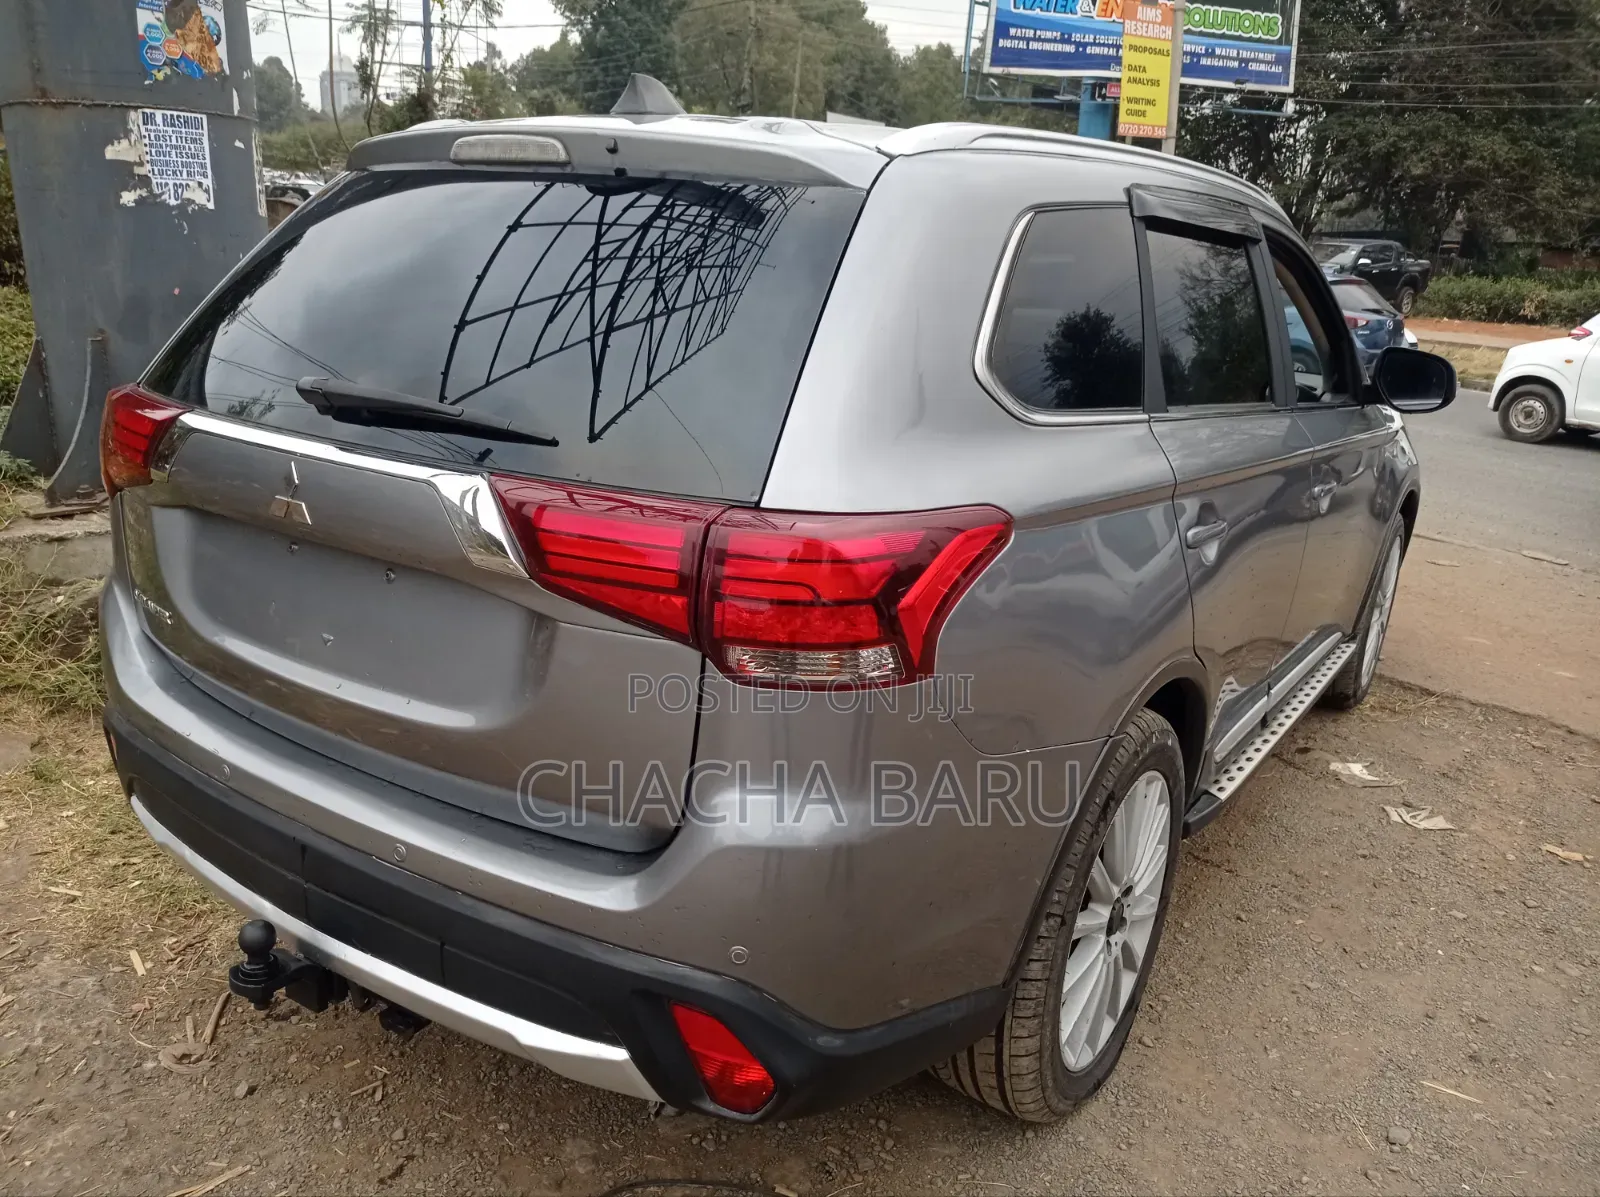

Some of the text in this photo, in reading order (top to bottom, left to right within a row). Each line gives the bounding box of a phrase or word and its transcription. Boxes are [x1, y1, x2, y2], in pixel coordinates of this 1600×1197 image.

[1136, 6, 1162, 22] AIMS
[1009, 27, 1034, 37] WATER
[1036, 30, 1061, 40] PUMPS
[1071, 33, 1094, 43] SOLAR
[1124, 19, 1172, 40] RESEARCH
[998, 38, 1027, 49] DIGITAL
[1029, 41, 1075, 53] ENGINEERING
[1086, 45, 1117, 56] GENERAL
[1128, 44, 1170, 57] PROPOSALS
[1183, 44, 1276, 62] ERVICE WATER TREATMENT
[1128, 64, 1147, 73] DATA
[1248, 62, 1283, 72] CHEMICALS
[1127, 76, 1160, 87] ANALYSIS
[1126, 96, 1156, 107] WRITING
[1125, 108, 1147, 117] GUIDE
[142, 111, 204, 131] DR. RASHIDI
[1120, 123, 1138, 135] 0720
[1139, 125, 1153, 135] 270
[148, 133, 204, 146] LOST ITEMS
[165, 144, 187, 152] POWER
[149, 150, 207, 161] LOVE ISSUES
[150, 158, 180, 169] BUSINESS
[152, 168, 209, 179] LUCKY RING
